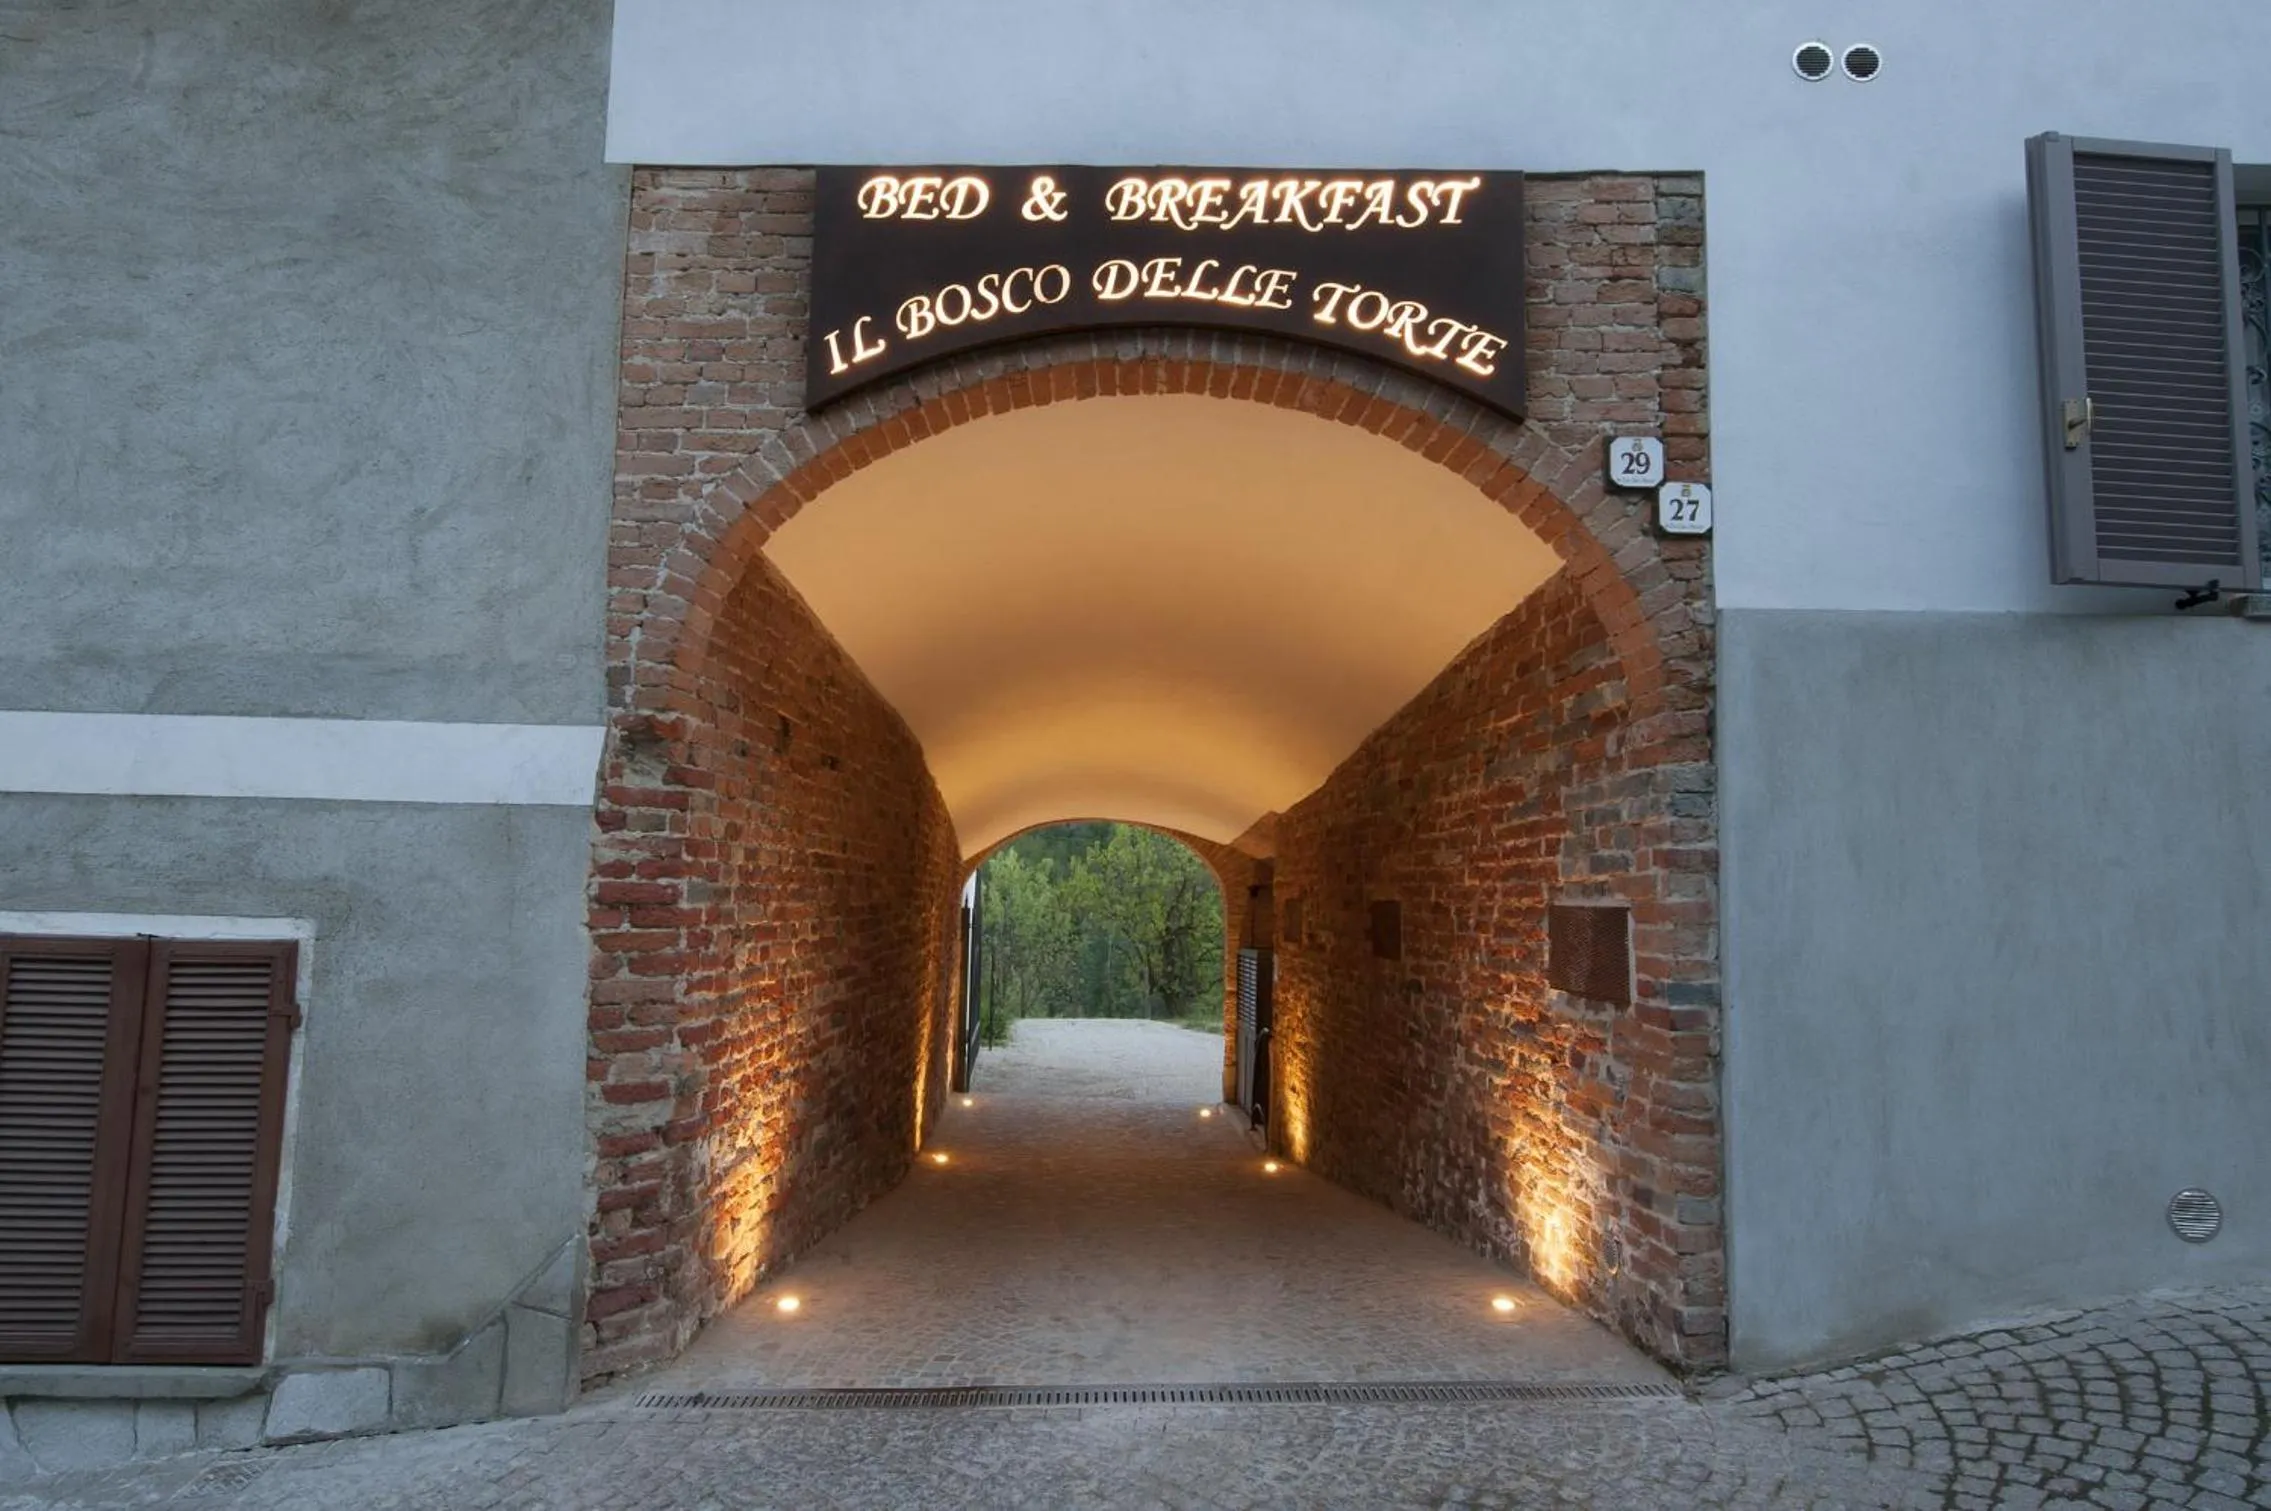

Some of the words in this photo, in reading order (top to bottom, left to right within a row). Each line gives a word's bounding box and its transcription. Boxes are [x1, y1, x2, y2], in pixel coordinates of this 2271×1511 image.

[857, 175, 990, 220] BED
[1021, 175, 1068, 222] &
[1104, 176, 1481, 231] BREAKFAST
[824, 315, 886, 375] IL
[895, 264, 1071, 340] BOSCO
[1092, 257, 1297, 310] DELLE
[1312, 282, 1508, 376] TORTE
[1620, 451, 1651, 475] 29
[1669, 498, 1700, 522] 27
